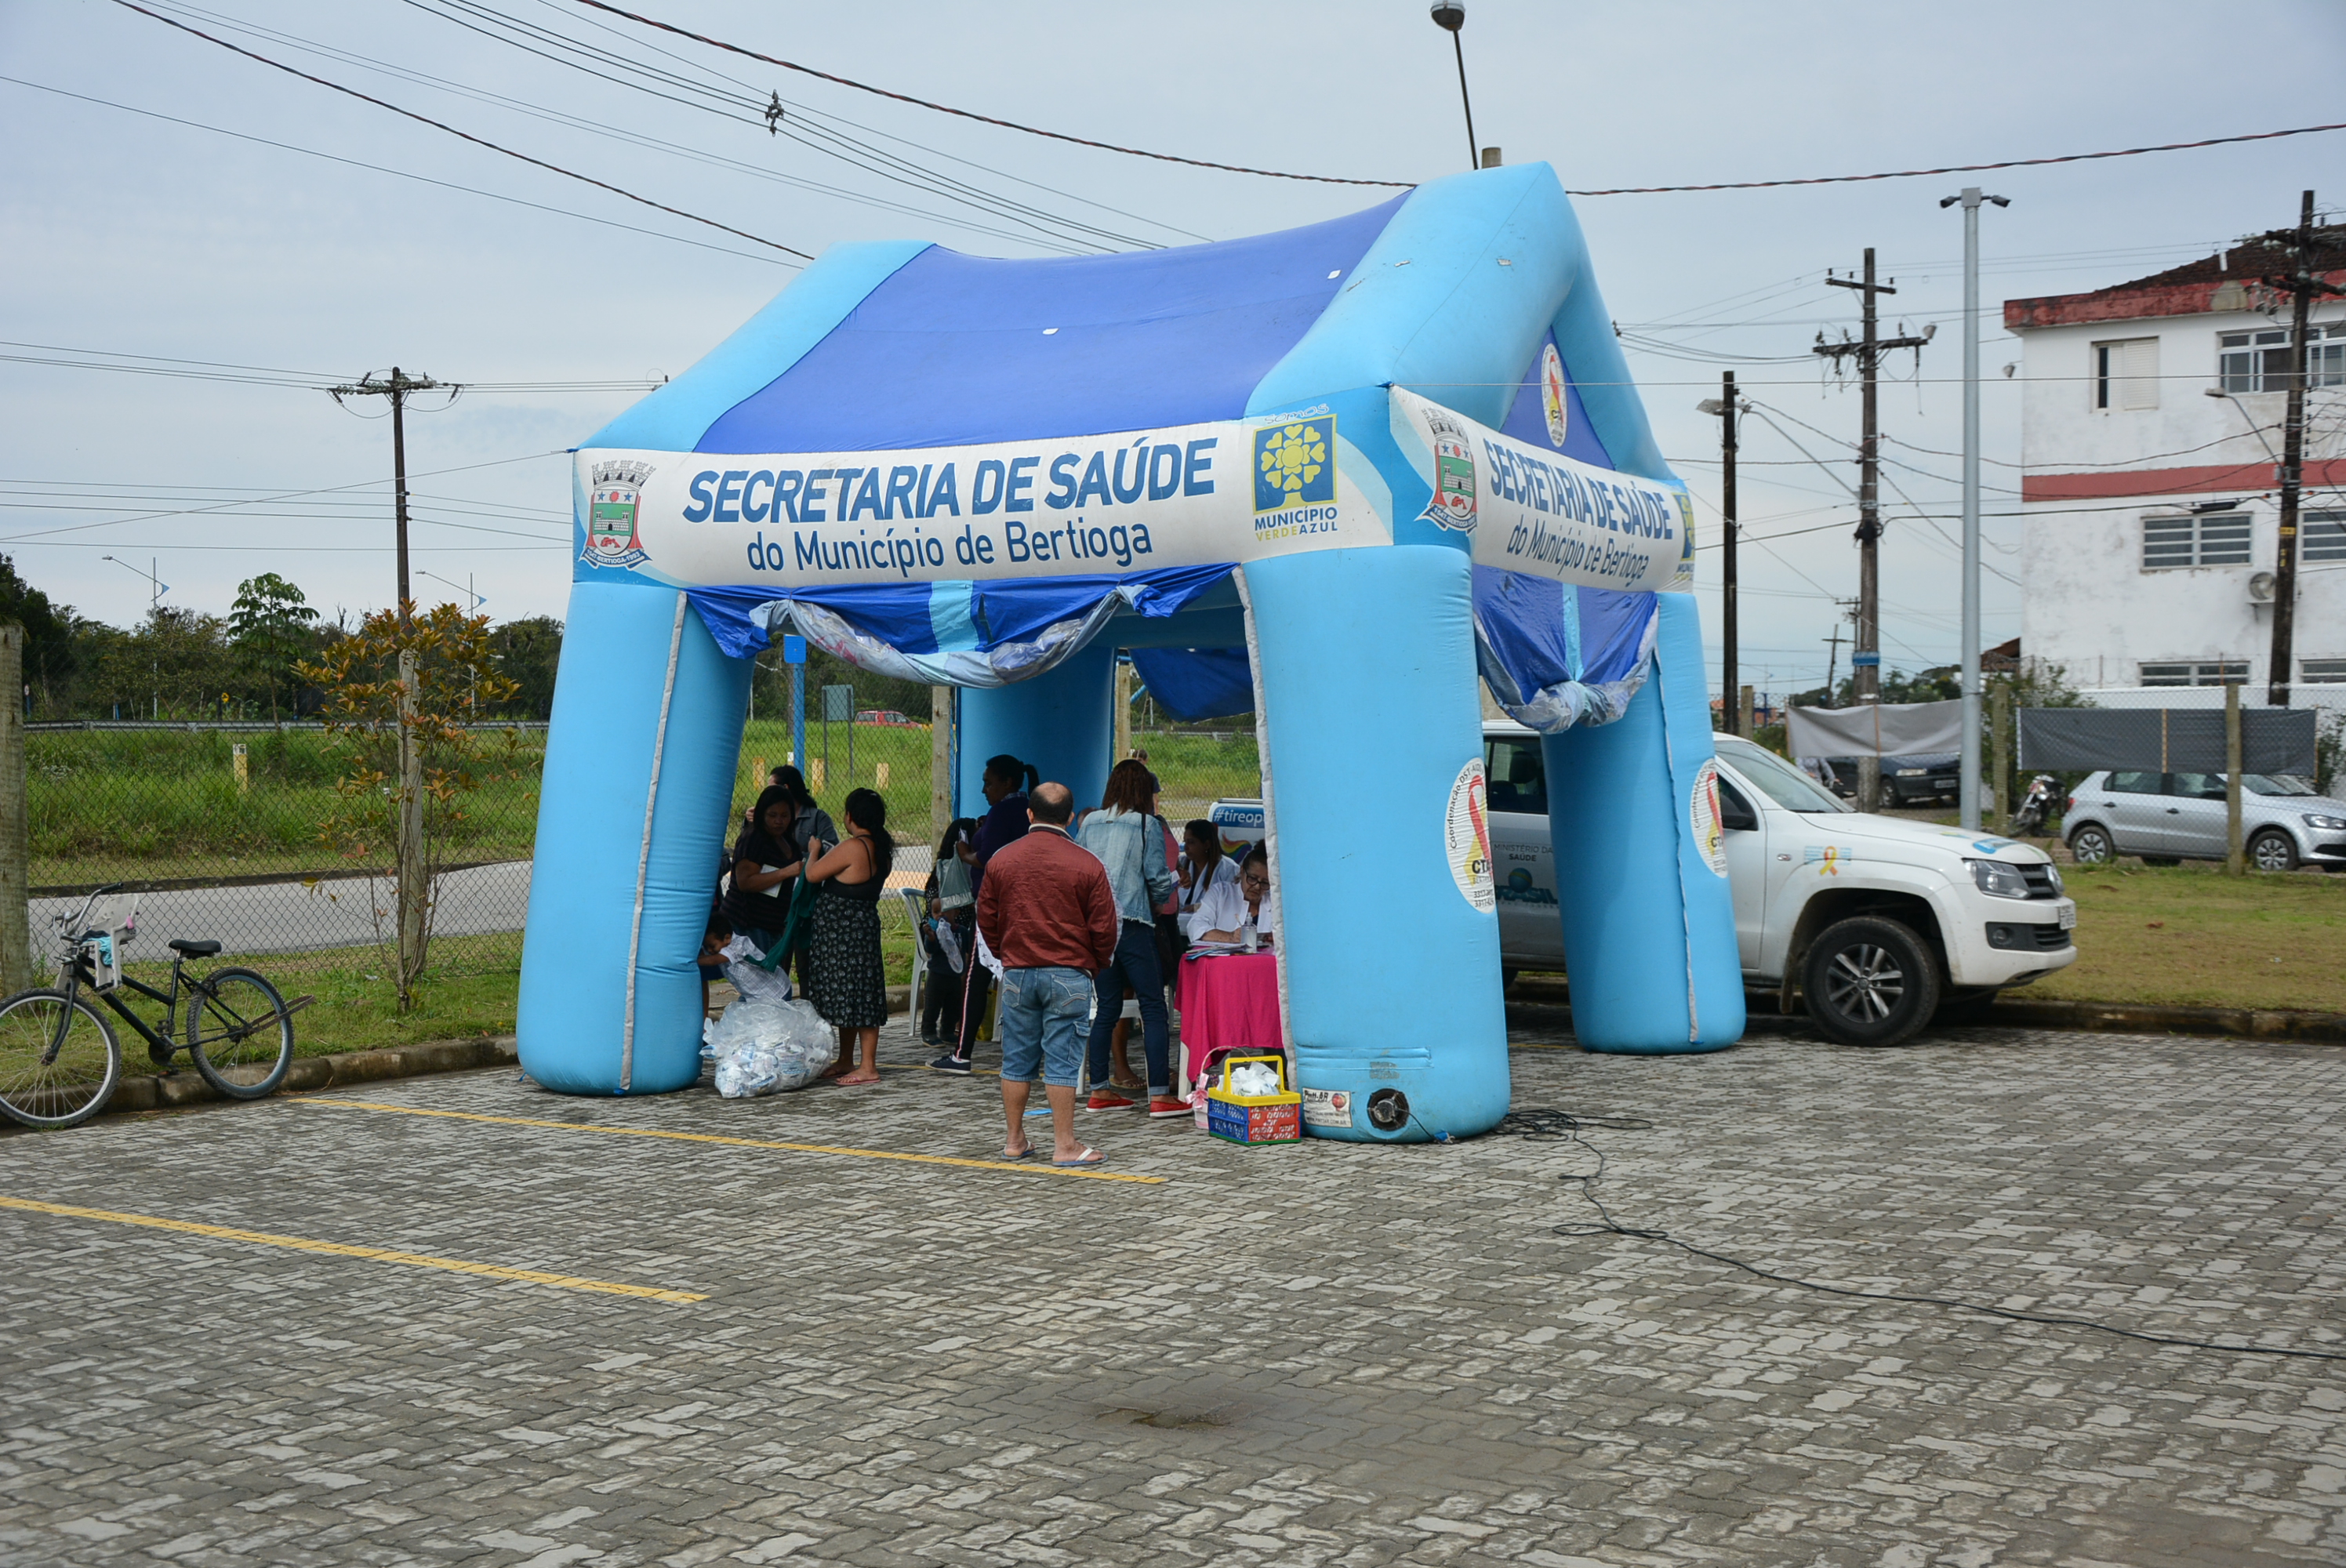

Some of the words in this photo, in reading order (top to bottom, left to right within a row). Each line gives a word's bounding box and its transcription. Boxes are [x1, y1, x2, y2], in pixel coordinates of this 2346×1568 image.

[1264, 403, 1329, 424] somos
[683, 463, 960, 523] SECRETARIA
[972, 456, 1040, 515] DE
[1044, 437, 1218, 509] SAÚDE
[1483, 437, 1595, 527] SECRETARIA
[1589, 478, 1618, 532] DE
[1613, 481, 1672, 539] SAÚDE
[1255, 506, 1337, 531] MUNICÍPIO
[1255, 521, 1338, 542] VERDEAZUL
[747, 531, 783, 571] do
[794, 526, 944, 577] Município
[956, 524, 994, 564] de
[1006, 517, 1153, 567] Bertioga
[1507, 514, 1521, 555] do
[1527, 519, 1584, 576] Município
[1583, 535, 1600, 571] de
[1603, 538, 1649, 587] Bertioga
[1214, 809, 1264, 826] #tireop
[1494, 844, 1539, 853] MINISTÉRIO
[1509, 853, 1537, 862] SAÚDE
[1495, 885, 1559, 905] RASIL
